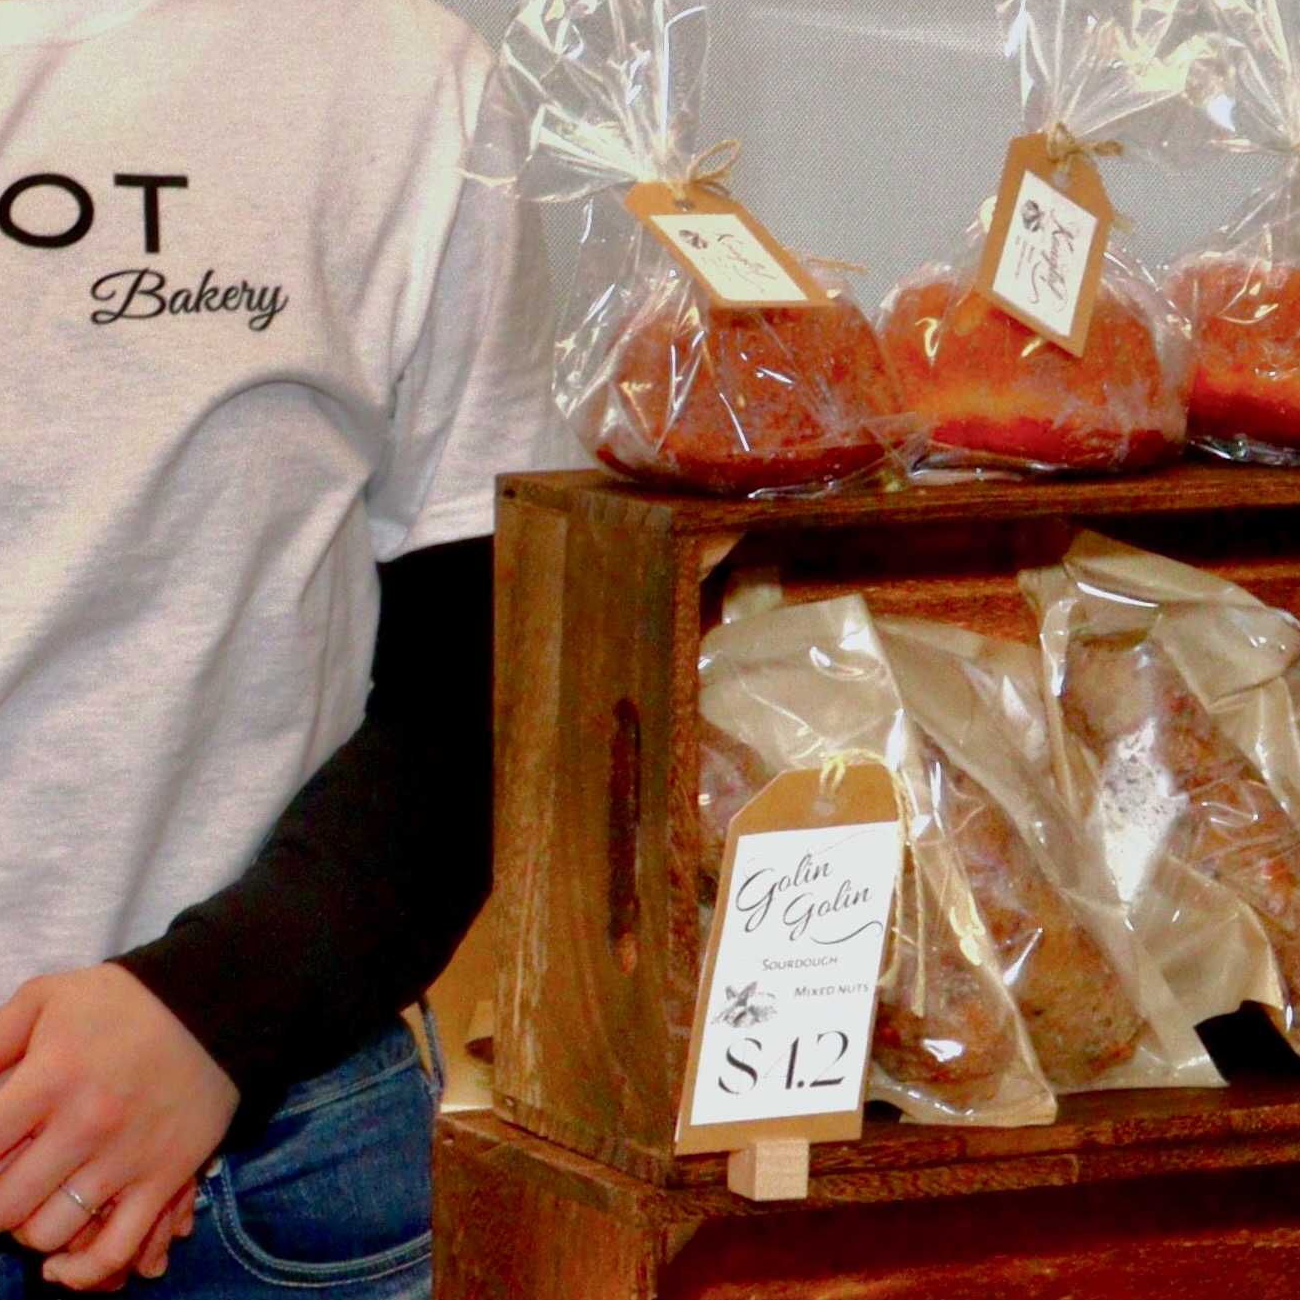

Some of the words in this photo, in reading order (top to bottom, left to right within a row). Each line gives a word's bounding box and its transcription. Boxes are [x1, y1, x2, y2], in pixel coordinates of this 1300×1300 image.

[90, 267, 289, 331] Bakery
[762, 956, 838, 972] SOURDOUGH
[794, 984, 836, 997] MIXED
[838, 983, 869, 996] NUTS
